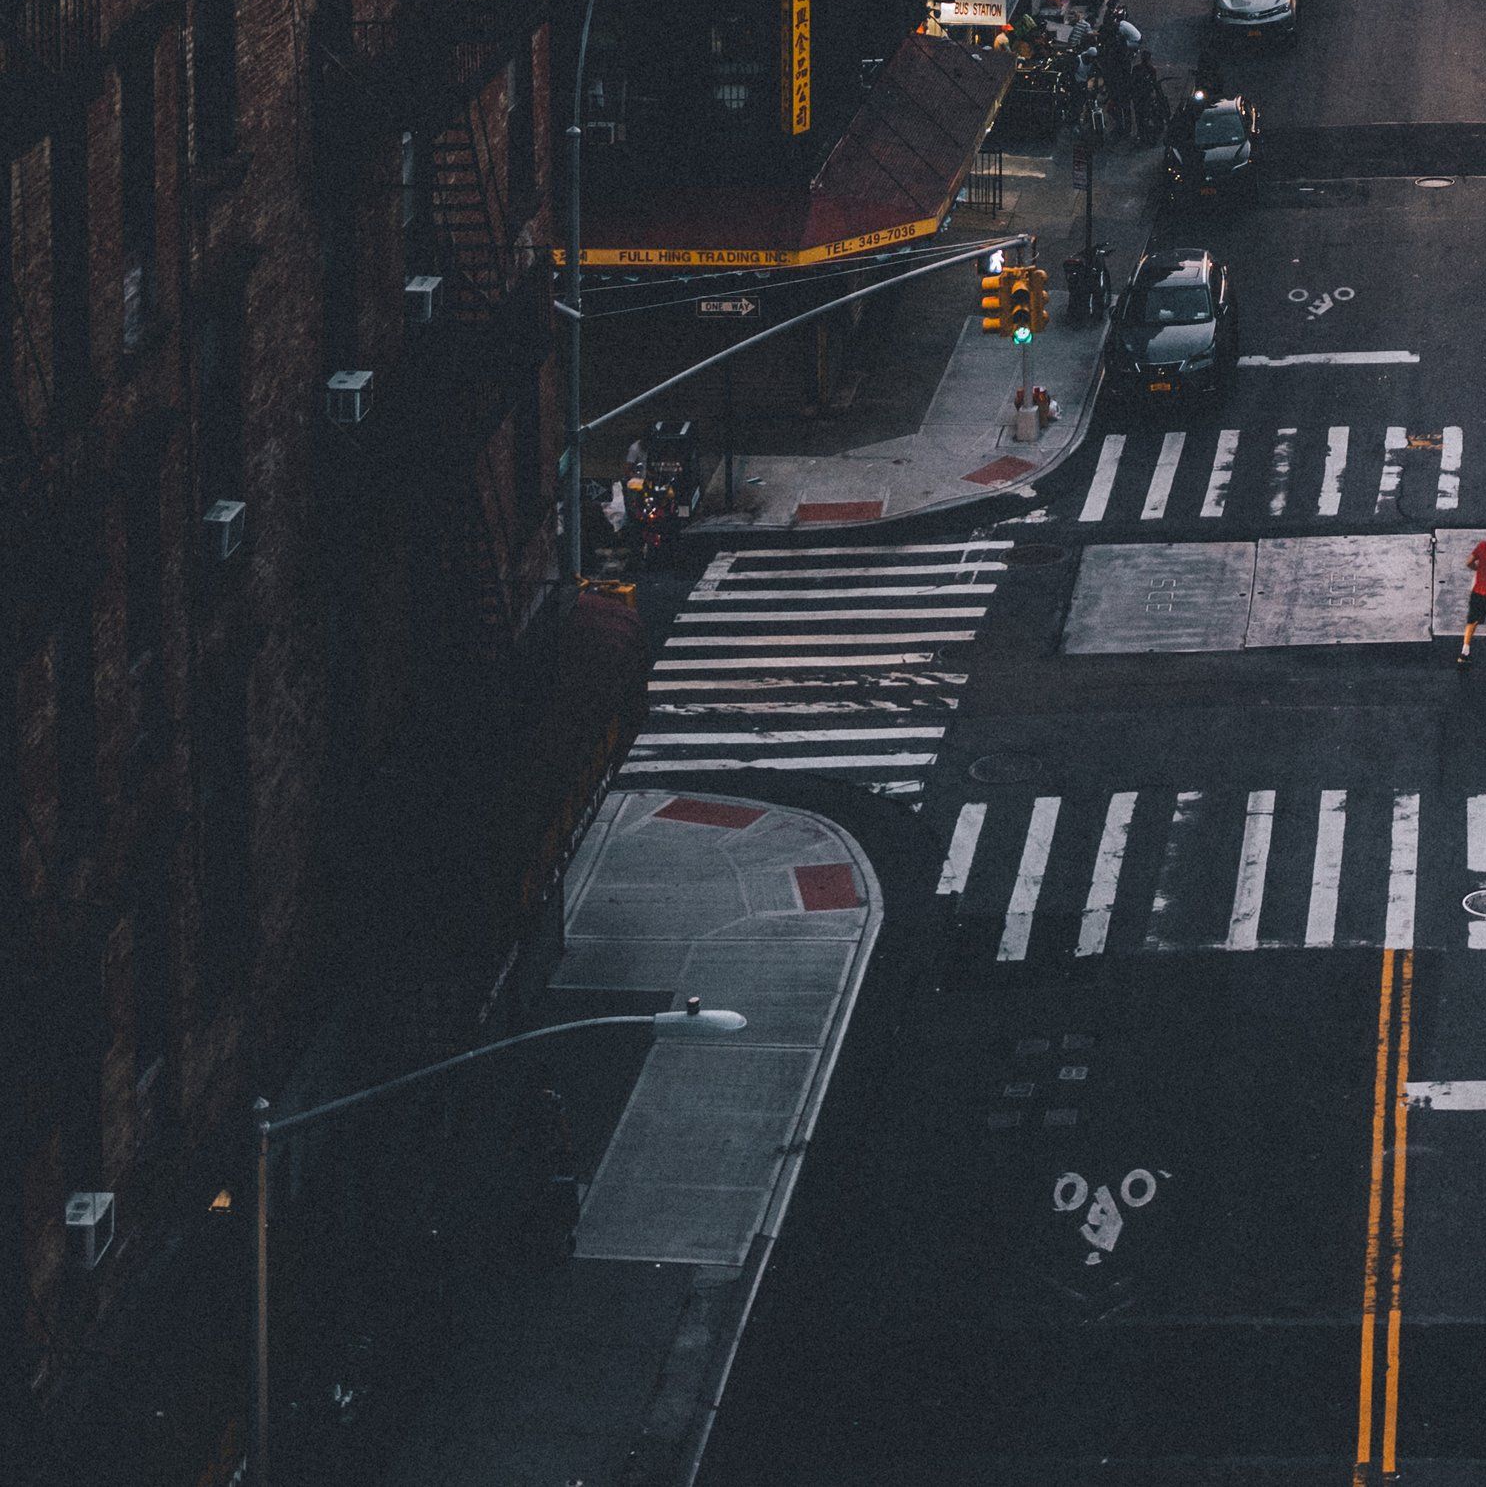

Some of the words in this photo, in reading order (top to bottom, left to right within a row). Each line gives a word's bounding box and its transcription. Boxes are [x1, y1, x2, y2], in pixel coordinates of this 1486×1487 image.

[954, 2, 969, 15] BUS
[972, 3, 1002, 17] STATION
[825, 241, 852, 256] TEL:
[858, 225, 915, 249] 349-7036
[619, 251, 652, 263] FULL
[658, 251, 691, 263] HING
[696, 251, 760, 264] TRADING
[764, 251, 791, 264] INC.
[705, 302, 723, 311] ONE
[730, 302, 750, 312] WAY
